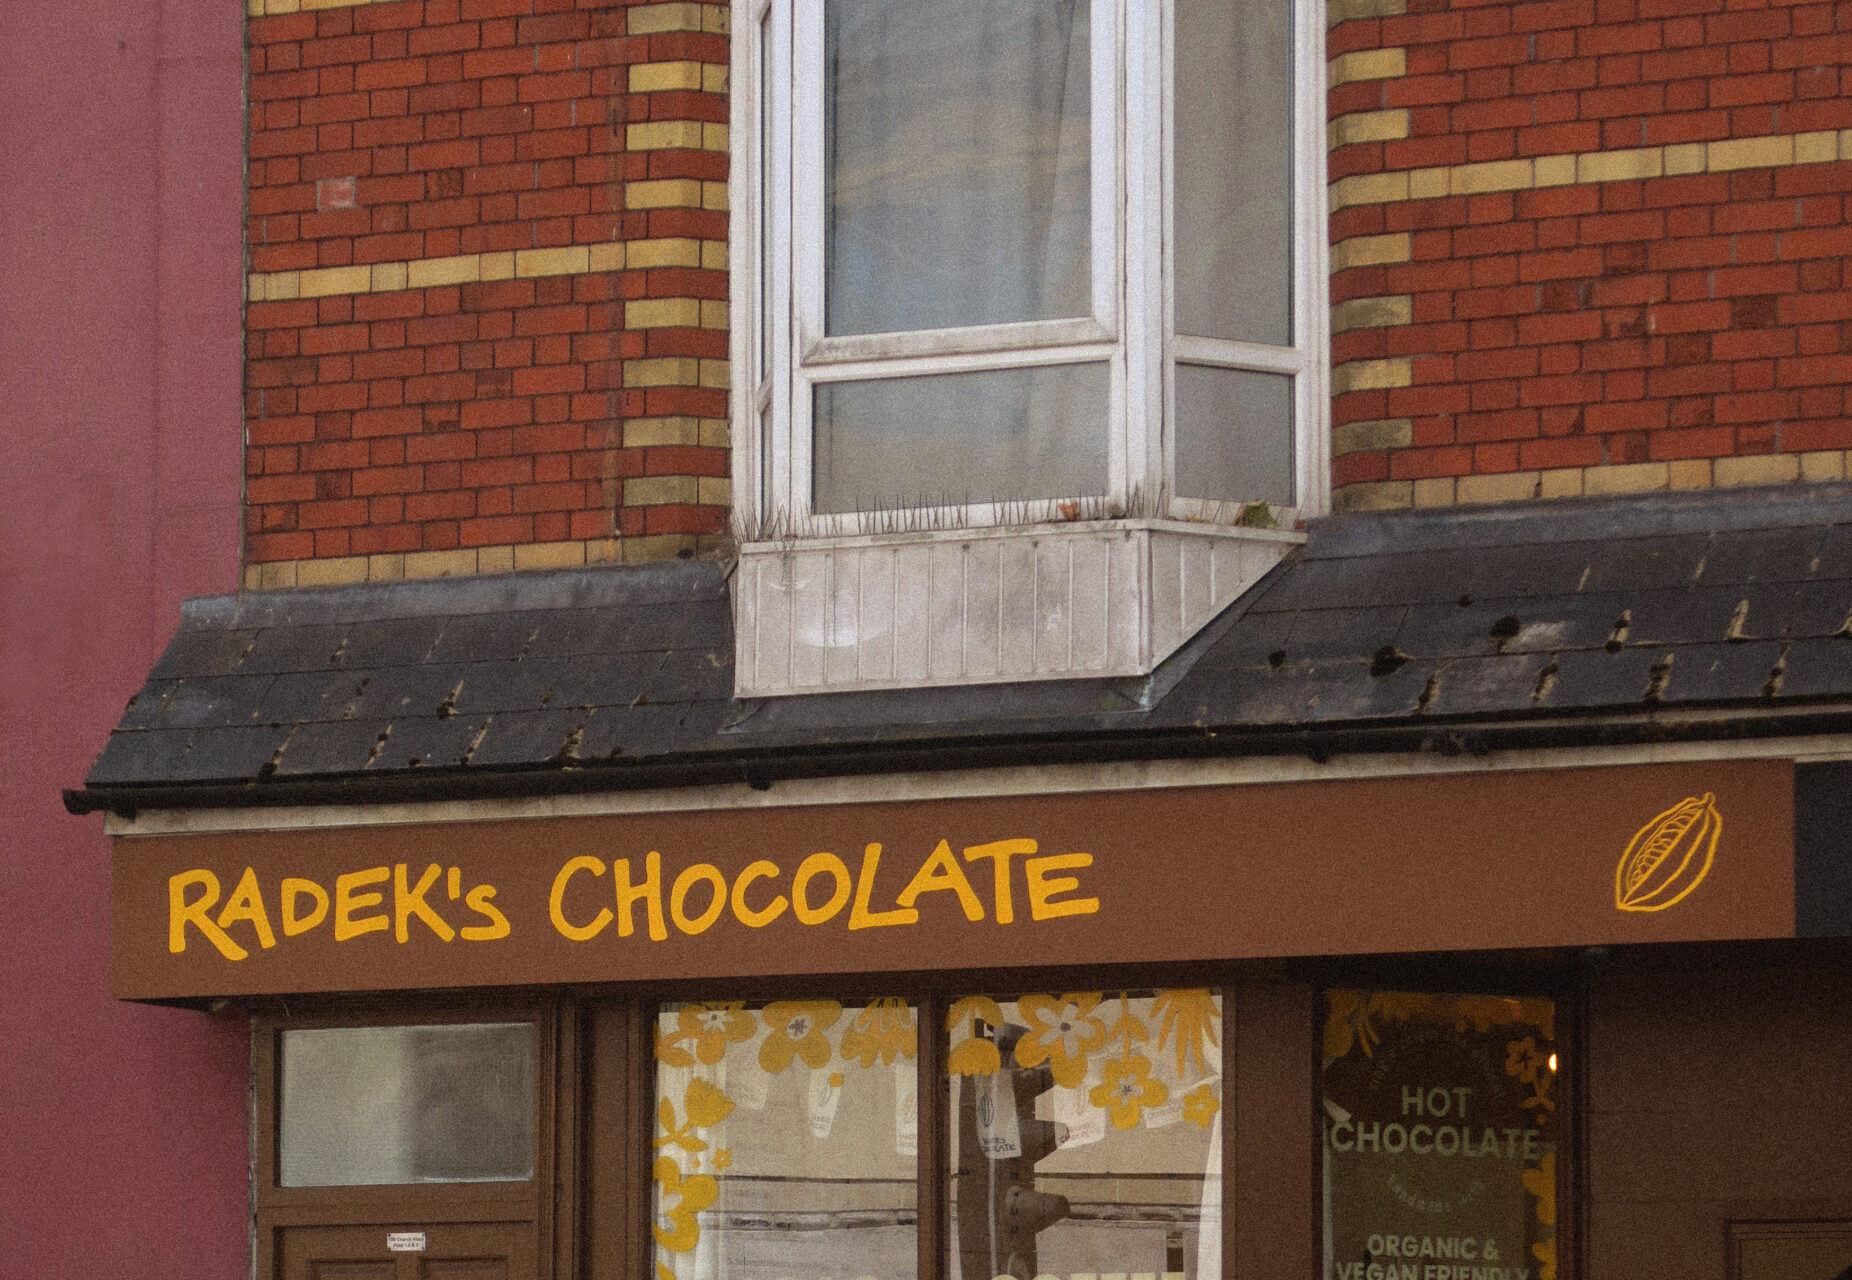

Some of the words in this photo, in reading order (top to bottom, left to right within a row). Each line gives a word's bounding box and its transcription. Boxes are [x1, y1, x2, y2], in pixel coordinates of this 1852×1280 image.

[548, 838, 1101, 942] CHOCOLATE
[1402, 1085, 1472, 1118] HOT
[1330, 1121, 1541, 1160] CHOCOLATE
[1366, 1234, 1478, 1260] ORGANIC
[1483, 1238, 1500, 1261] &
